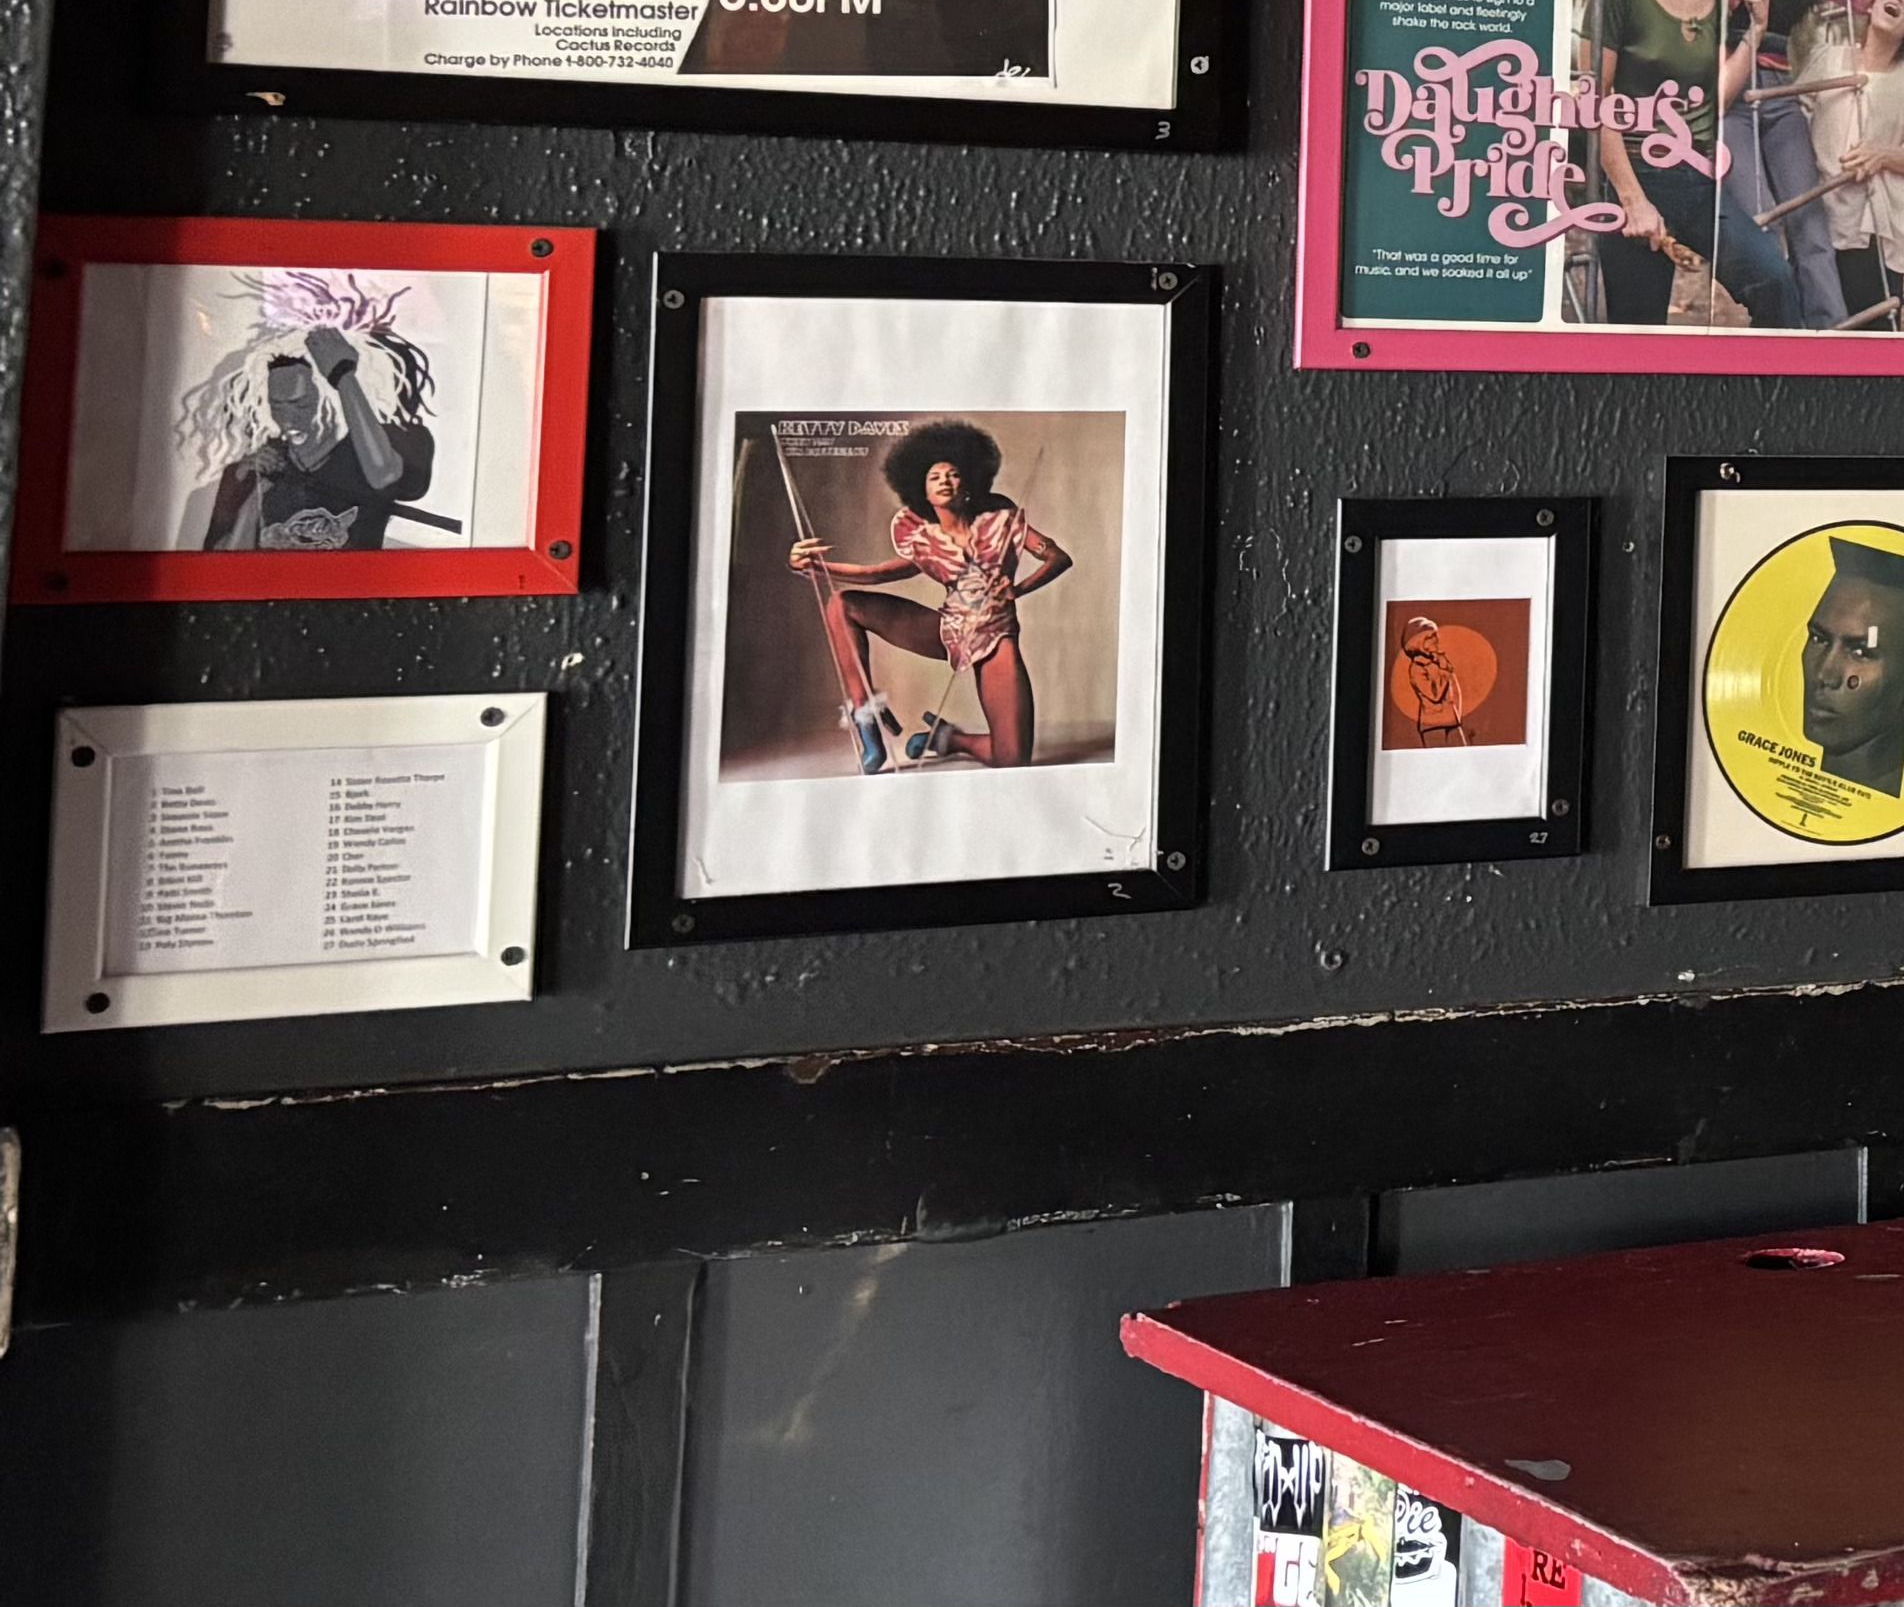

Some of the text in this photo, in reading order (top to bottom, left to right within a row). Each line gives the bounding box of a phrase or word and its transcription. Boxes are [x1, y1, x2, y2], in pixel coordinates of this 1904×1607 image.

[534, 24, 682, 42] Locations Including
[556, 38, 676, 52] Cactus Records
[424, 53, 486, 69] Charge
[490, 53, 509, 69] by
[512, 54, 561, 68] Phone
[1354, 39, 1731, 180] Daughters'
[1381, 129, 1626, 248] Pride
[1373, 249, 1518, 264] "That was a good time for
[1395, 265, 1418, 275] and
[1422, 267, 1439, 276] we
[1442, 267, 1483, 278] soaked
[1486, 268, 1493, 278] it
[1496, 269, 1509, 279] all
[1512, 270, 1532, 281] up"
[1737, 730, 1817, 768] GRACE JONES
[1529, 832, 1548, 844] 27
[1108, 883, 1131, 899] 2
